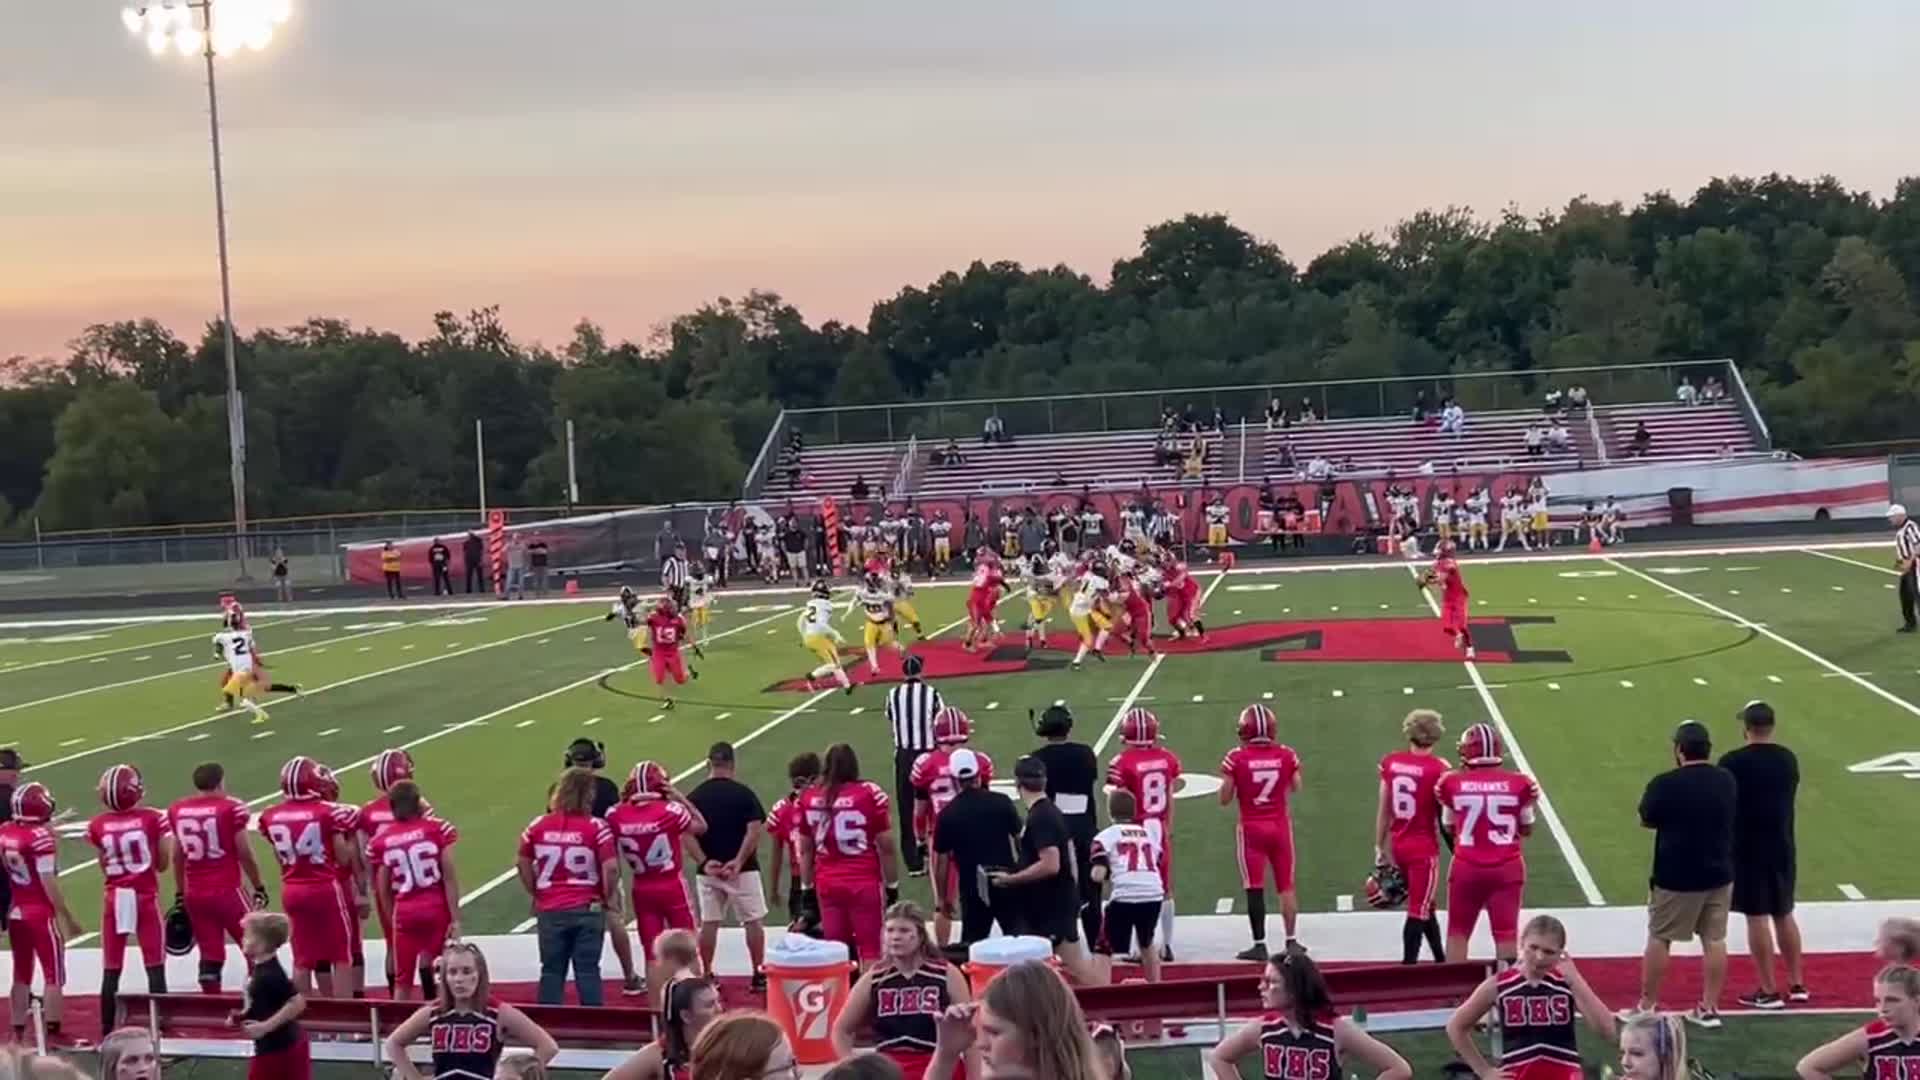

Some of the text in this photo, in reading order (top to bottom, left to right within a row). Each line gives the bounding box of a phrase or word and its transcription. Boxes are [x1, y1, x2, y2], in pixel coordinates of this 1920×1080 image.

[232, 637, 247, 656] 2
[1142, 771, 1168, 814] 8
[1252, 770, 1281, 806] 7
[1392, 775, 1418, 821] 6
[176, 817, 227, 861] 61
[805, 809, 868, 856] 76
[1452, 794, 1520, 847] 75
[101, 829, 152, 875] 10
[383, 841, 442, 894] 36
[534, 844, 600, 890] 79
[1116, 841, 1157, 873] 71
[798, 982, 825, 1014] G
